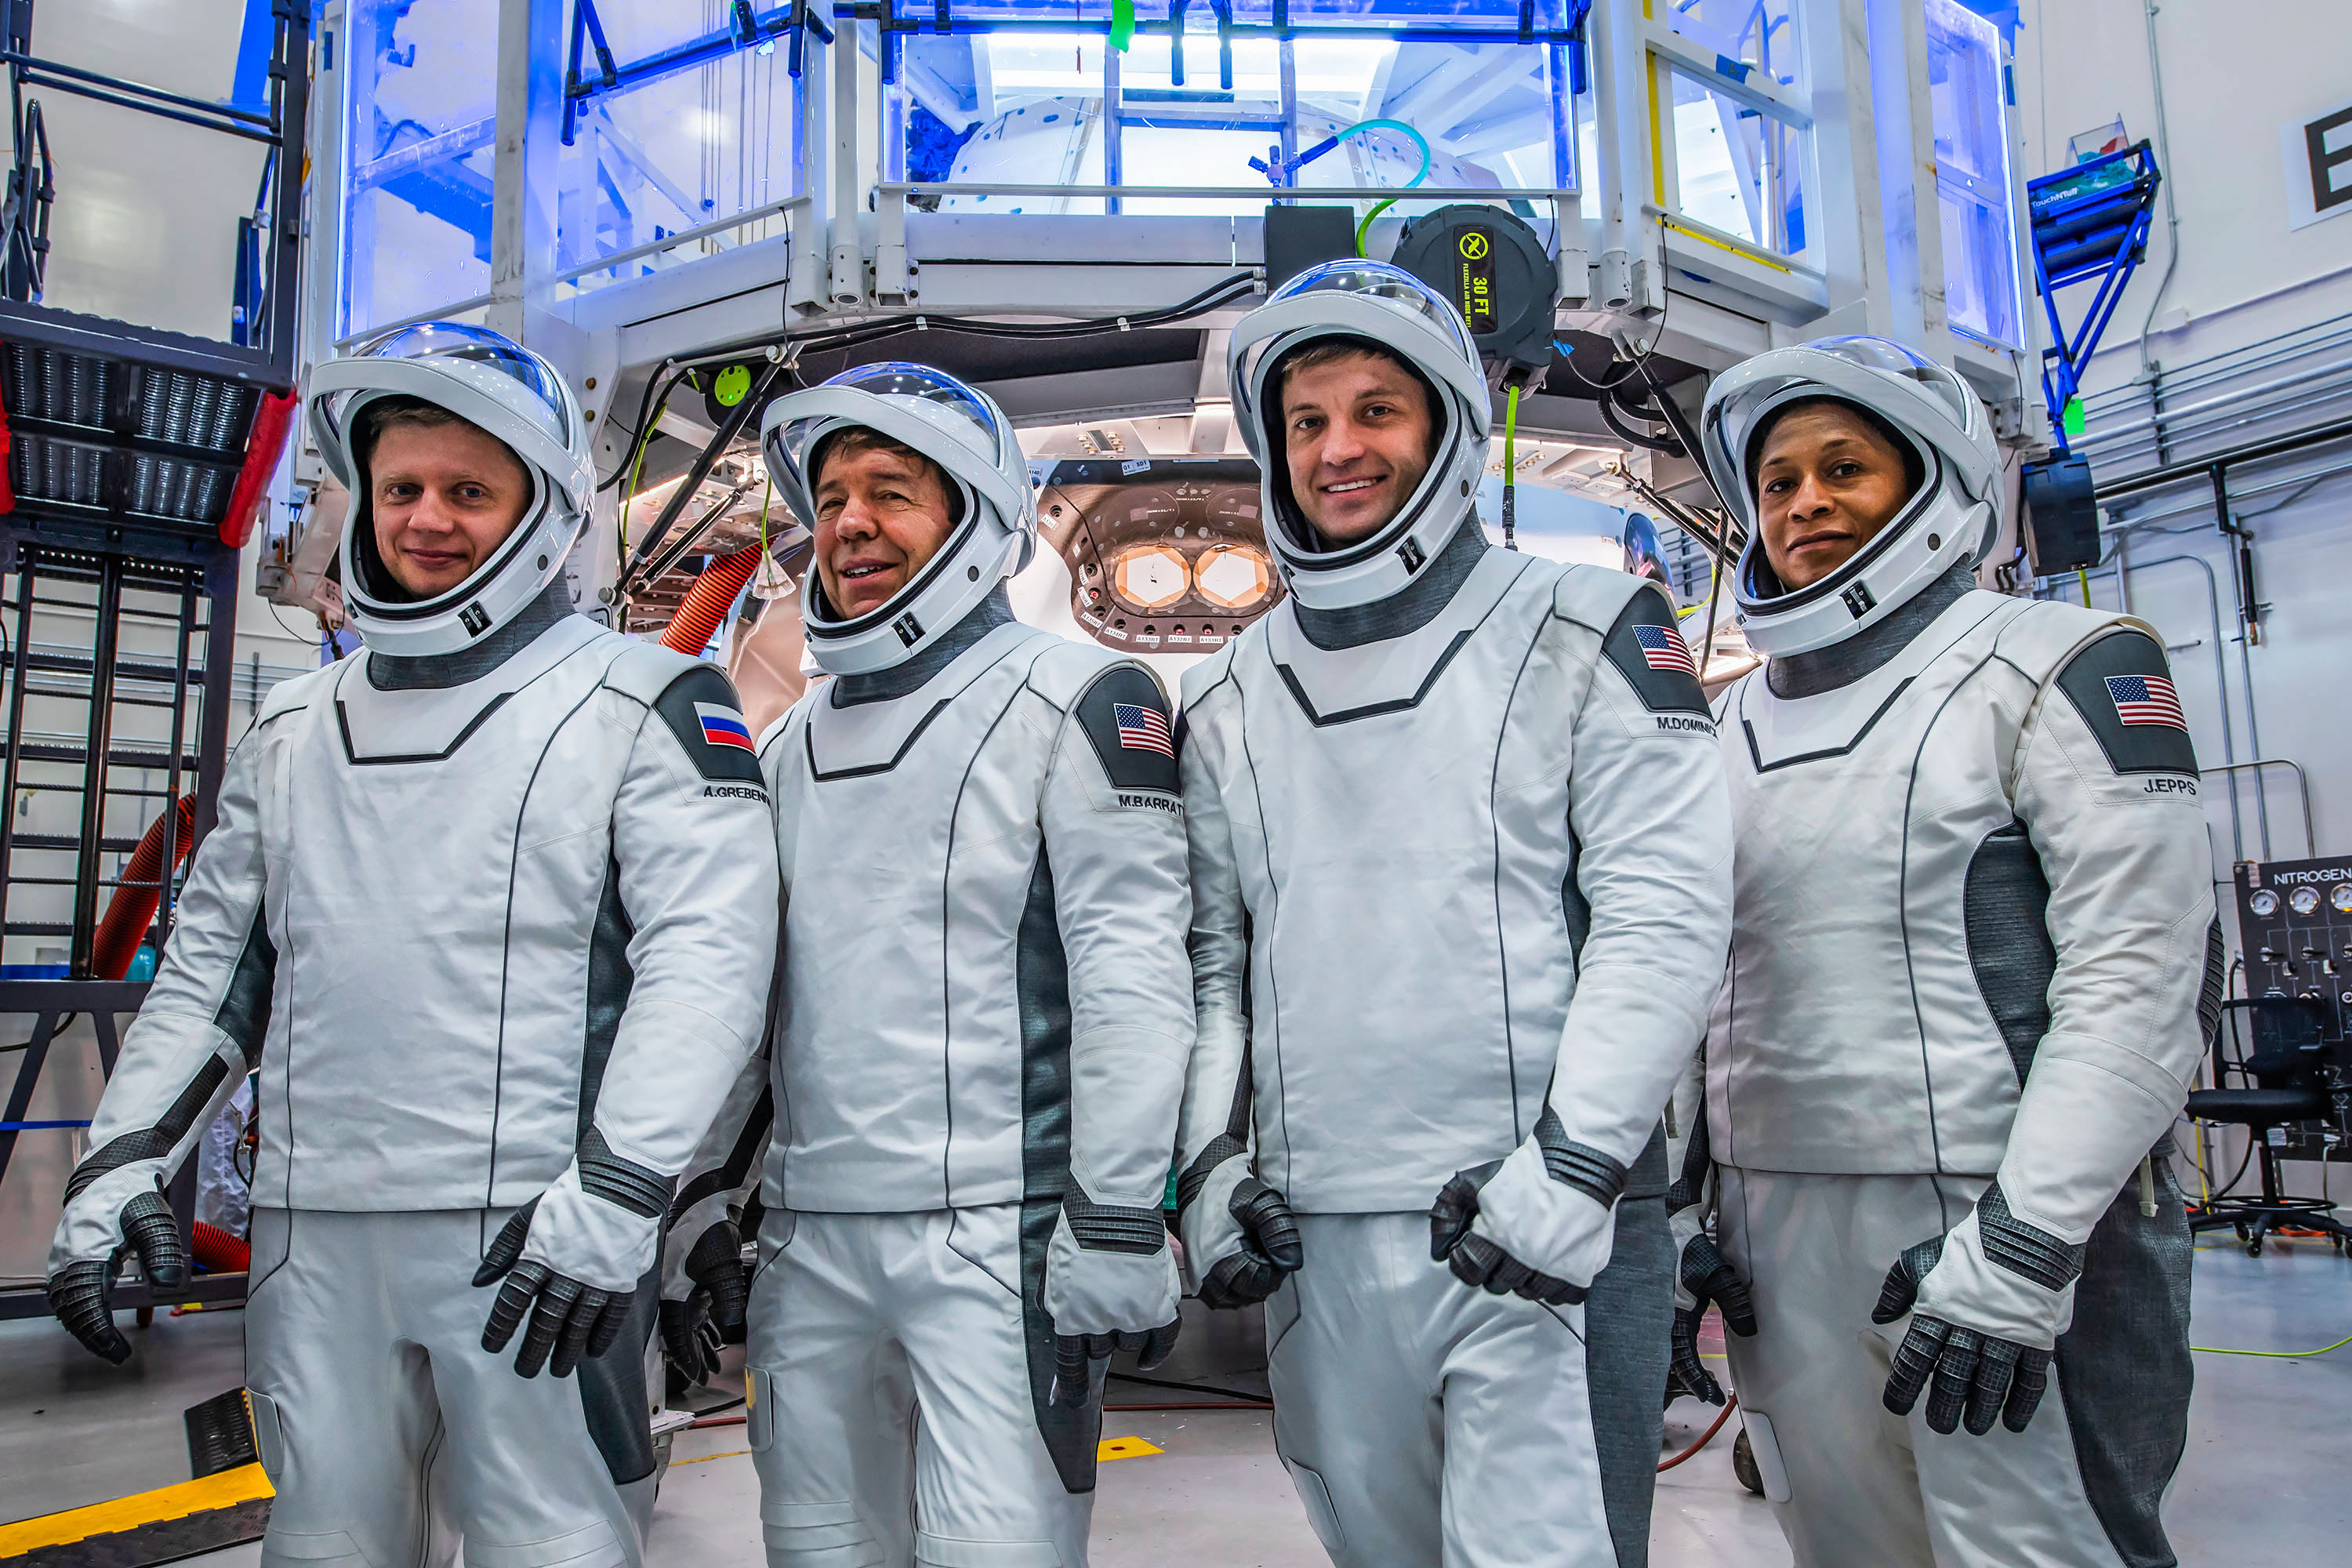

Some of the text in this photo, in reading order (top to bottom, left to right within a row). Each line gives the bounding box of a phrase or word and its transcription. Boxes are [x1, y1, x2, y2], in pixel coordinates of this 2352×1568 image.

[1473, 277, 1489, 315] 30 FT
[2143, 779, 2196, 795] J.EPPS
[2274, 868, 2352, 884] NITROGEN
